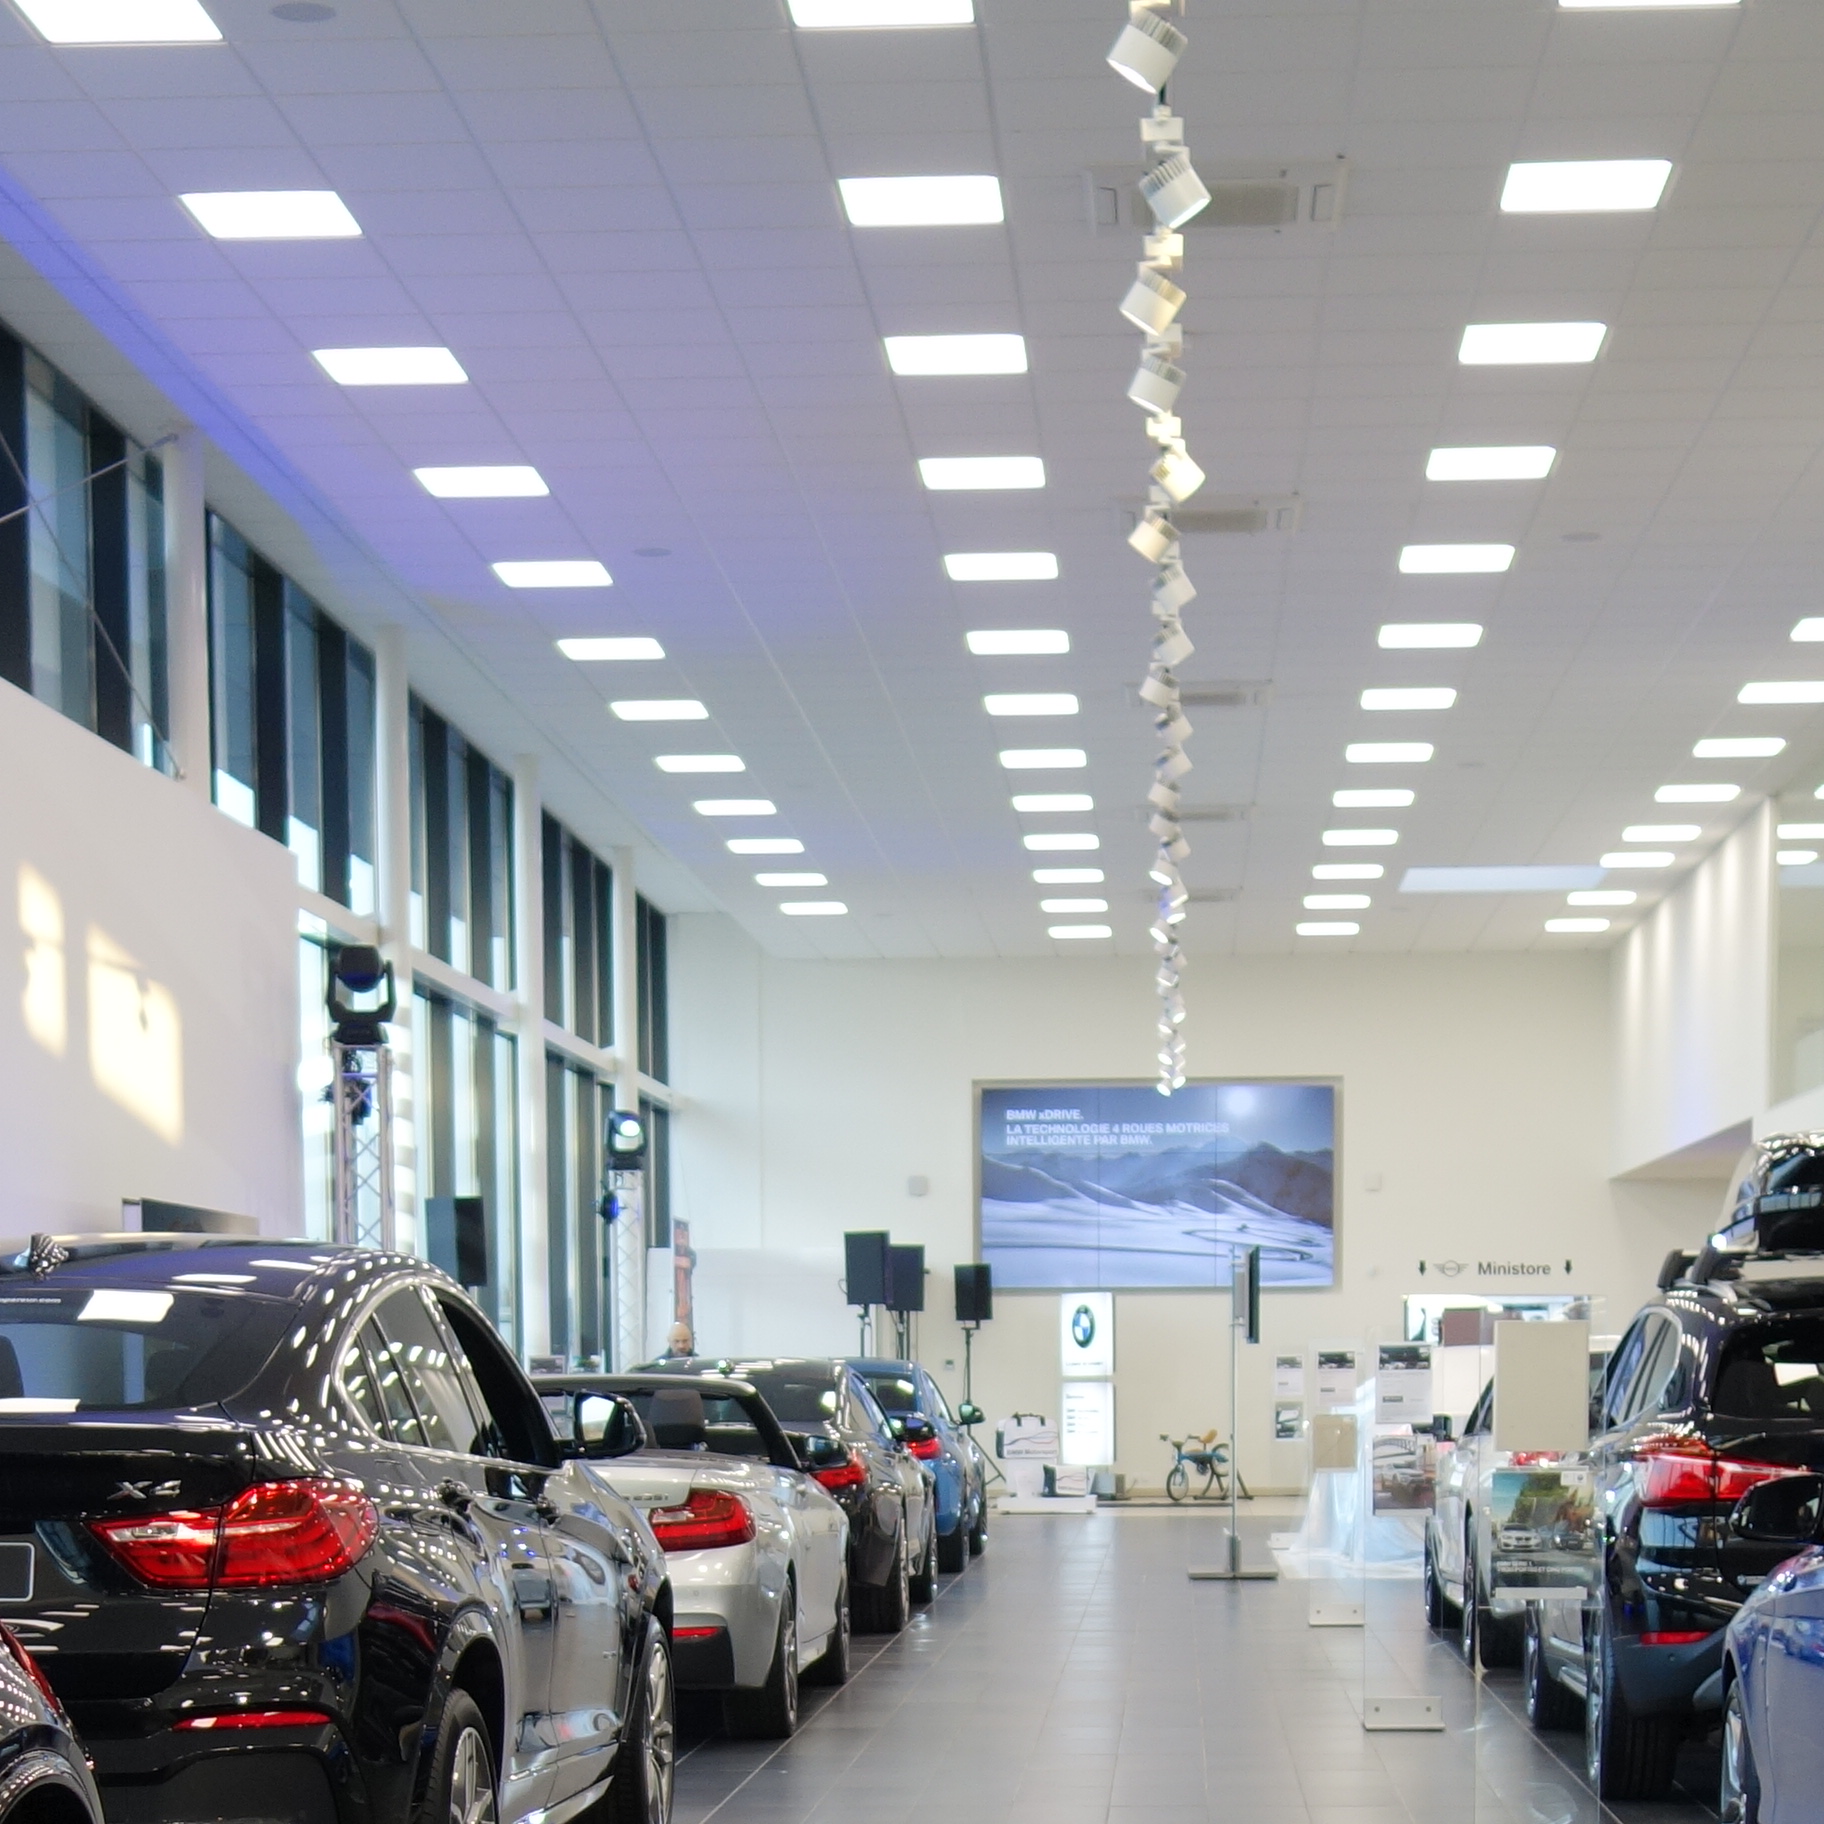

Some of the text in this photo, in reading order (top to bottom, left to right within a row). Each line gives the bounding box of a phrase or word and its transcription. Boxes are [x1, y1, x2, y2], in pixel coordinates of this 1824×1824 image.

[1006, 1109, 1084, 1120] BMW xDRIVE.
[1006, 1122, 1230, 1134] LA TECHNOLOGIE 4 ROUES MOTRICES
[1006, 1135, 1153, 1145] INTELLIGENTE PAR BMW.
[1478, 1261, 1552, 1275] Ministore
[106, 1480, 182, 1500] X4
